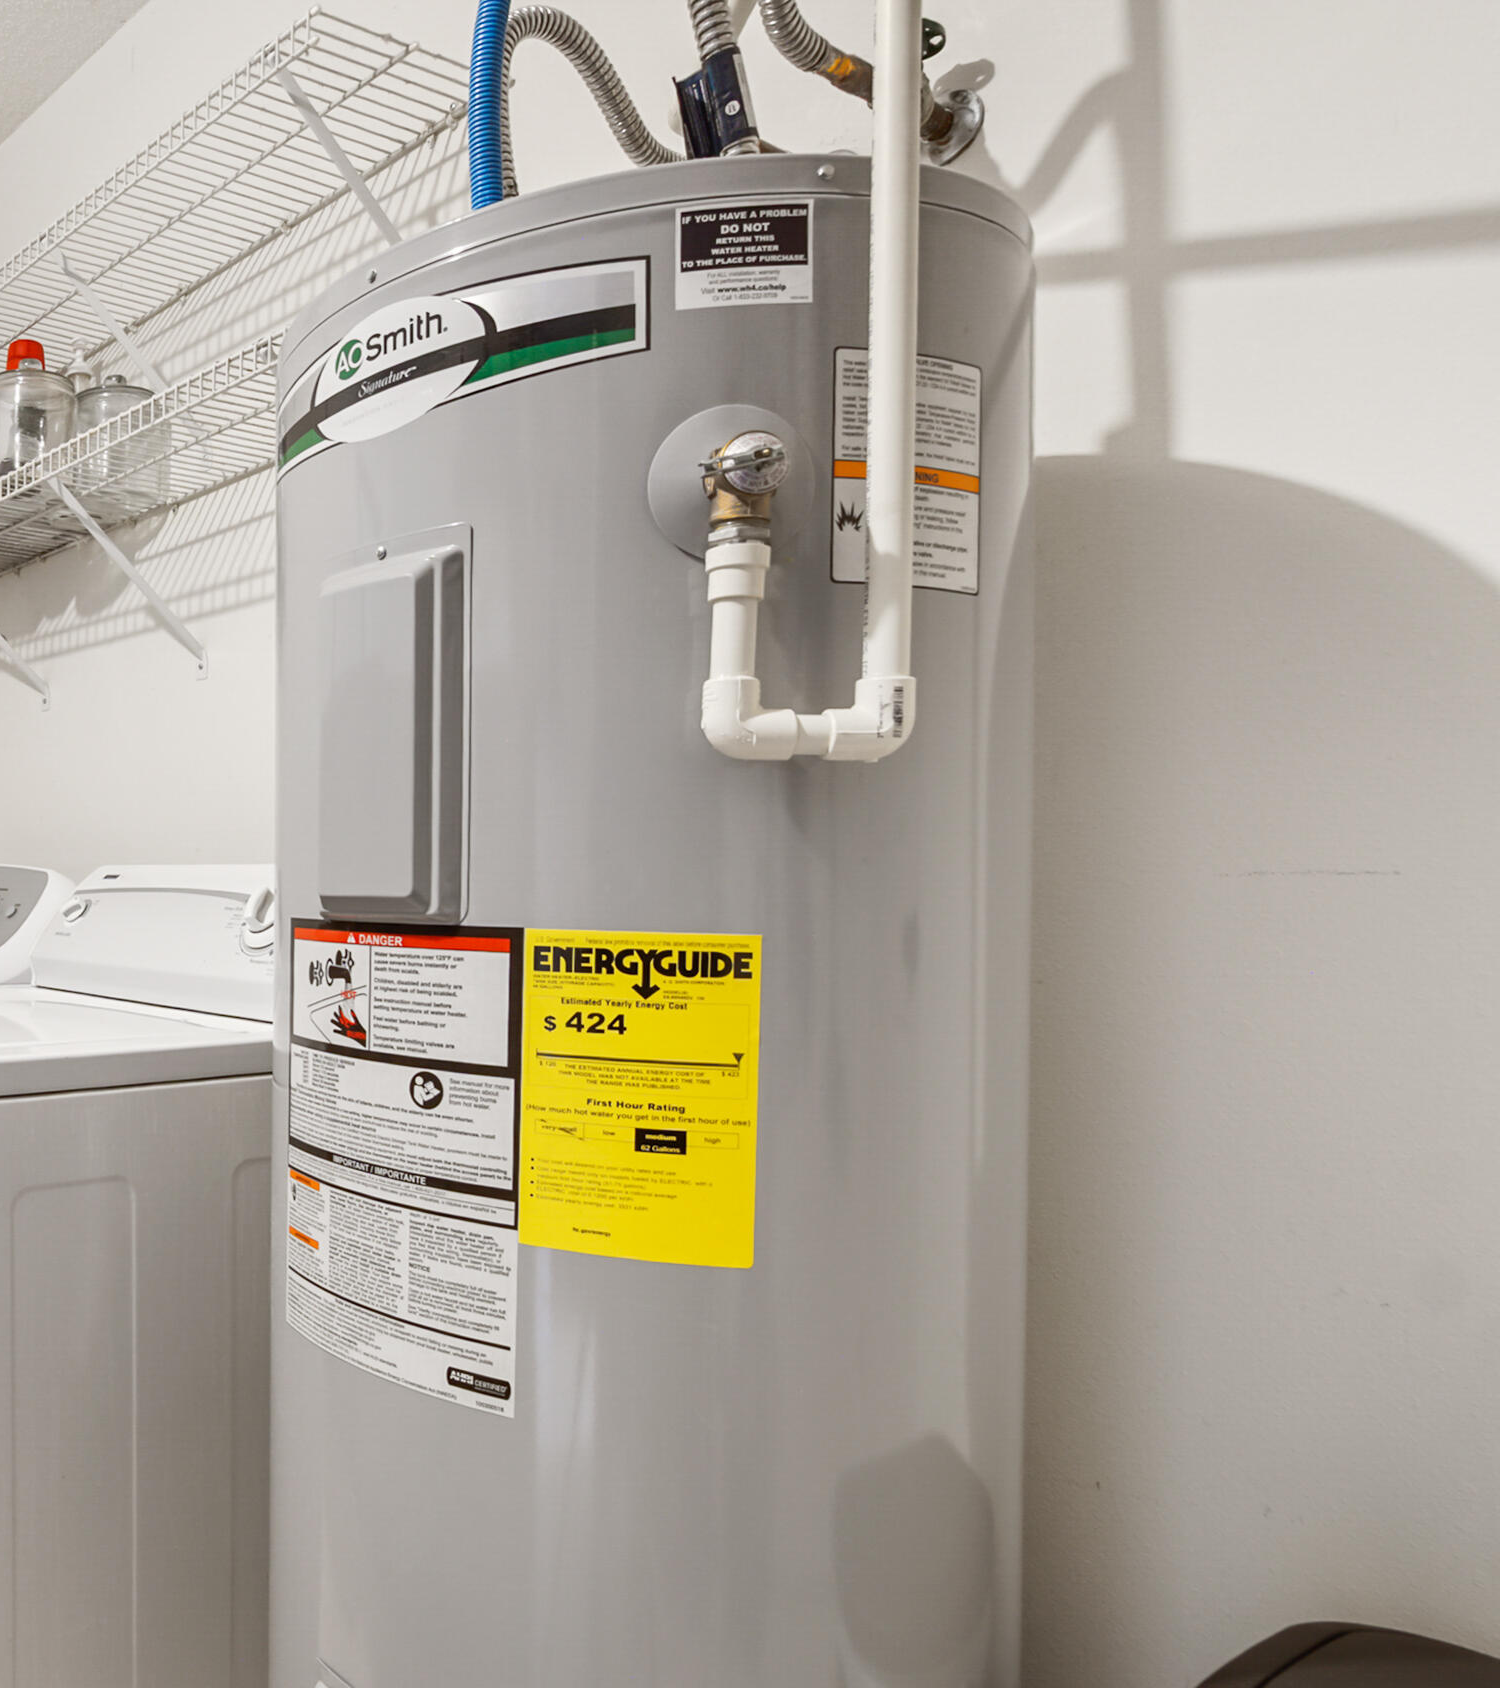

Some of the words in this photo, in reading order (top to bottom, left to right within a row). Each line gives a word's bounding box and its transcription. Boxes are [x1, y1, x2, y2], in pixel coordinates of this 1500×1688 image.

[695, 214, 716, 223] YOU
[719, 211, 747, 221] HAVE
[760, 209, 807, 218] PROBLEM
[721, 224, 739, 234] DO
[743, 222, 770, 233] NOT
[716, 236, 752, 244] RETURN
[711, 247, 742, 255] WATER
[744, 245, 779, 253] HEATER
[696, 259, 713, 267] THE
[715, 257, 743, 265] PLACE
[358, 366, 417, 398] Signature
[359, 934, 403, 946] DANGER
[533, 945, 753, 980] ENERGYGUIDE
[561, 997, 602, 1007] Estimated
[605, 999, 632, 1009] Yearly
[635, 1001, 665, 1011] Energy
[669, 1002, 687, 1010] Cost
[543, 1015, 557, 1032] $
[565, 1011, 627, 1035] 424
[586, 1098, 612, 1107] First
[616, 1101, 643, 1109] Hour
[648, 1103, 685, 1114] Rating
[634, 1113, 649, 1121] get
[651, 1144, 680, 1153] Gallons
[332, 1155, 368, 1174] IMPORTANT
[373, 1166, 427, 1185] IMPORTANTE
[408, 1262, 430, 1273] NOTICE
